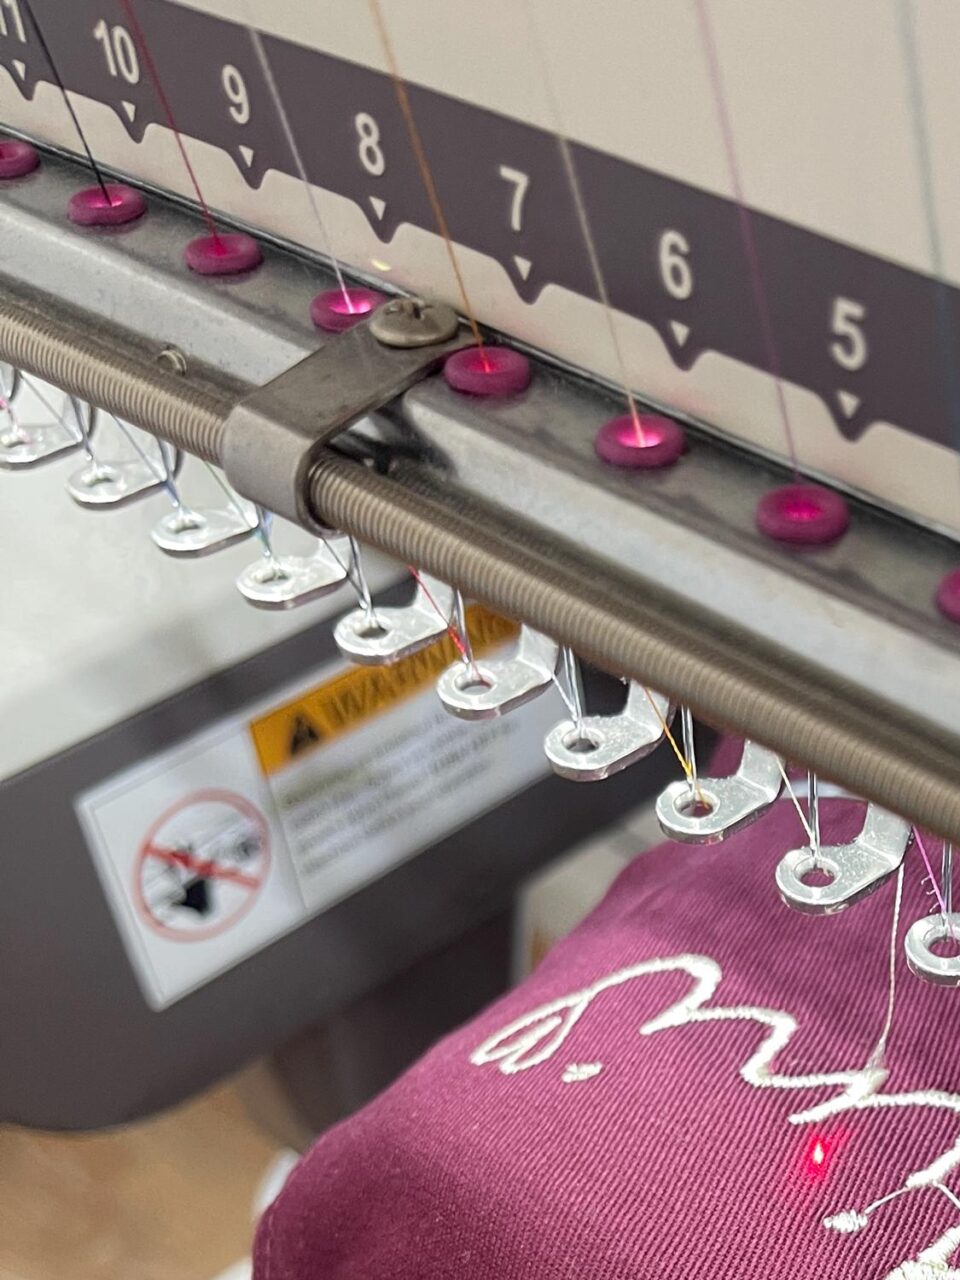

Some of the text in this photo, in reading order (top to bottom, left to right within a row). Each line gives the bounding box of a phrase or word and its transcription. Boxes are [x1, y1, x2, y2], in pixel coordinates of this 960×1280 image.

[93, 18, 140, 84] 10
[221, 64, 251, 124] 9
[355, 112, 385, 176] 8
[499, 165, 530, 231] 7
[659, 230, 692, 299] 6
[831, 297, 867, 370] 5
